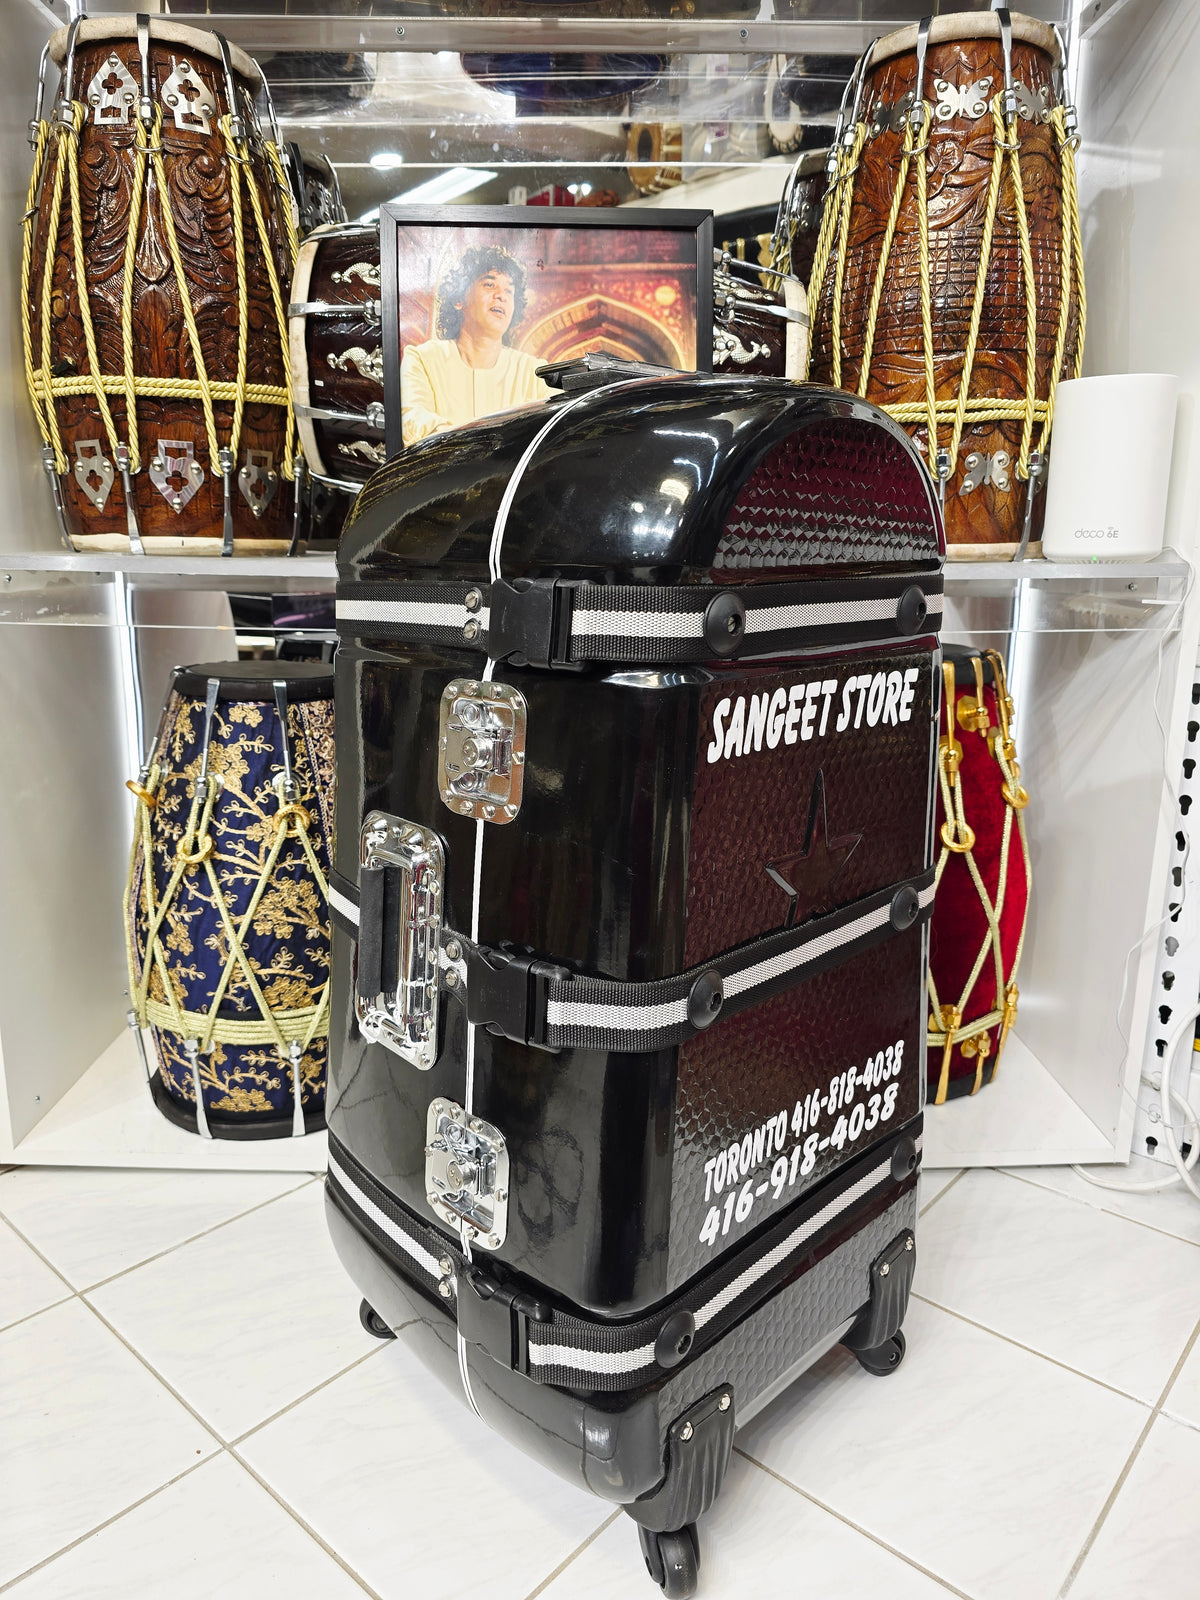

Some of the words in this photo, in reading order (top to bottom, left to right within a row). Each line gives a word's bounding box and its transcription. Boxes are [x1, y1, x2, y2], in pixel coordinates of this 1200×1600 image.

[1074, 528, 1105, 539] deco
[1106, 529, 1119, 539] 6E
[707, 679, 838, 764] SANGEET
[836, 668, 919, 732] STORE
[699, 1082, 899, 1246] 416-918-4038
[704, 1109, 788, 1202] TORONTO
[790, 1039, 905, 1138] 416-818-4038
